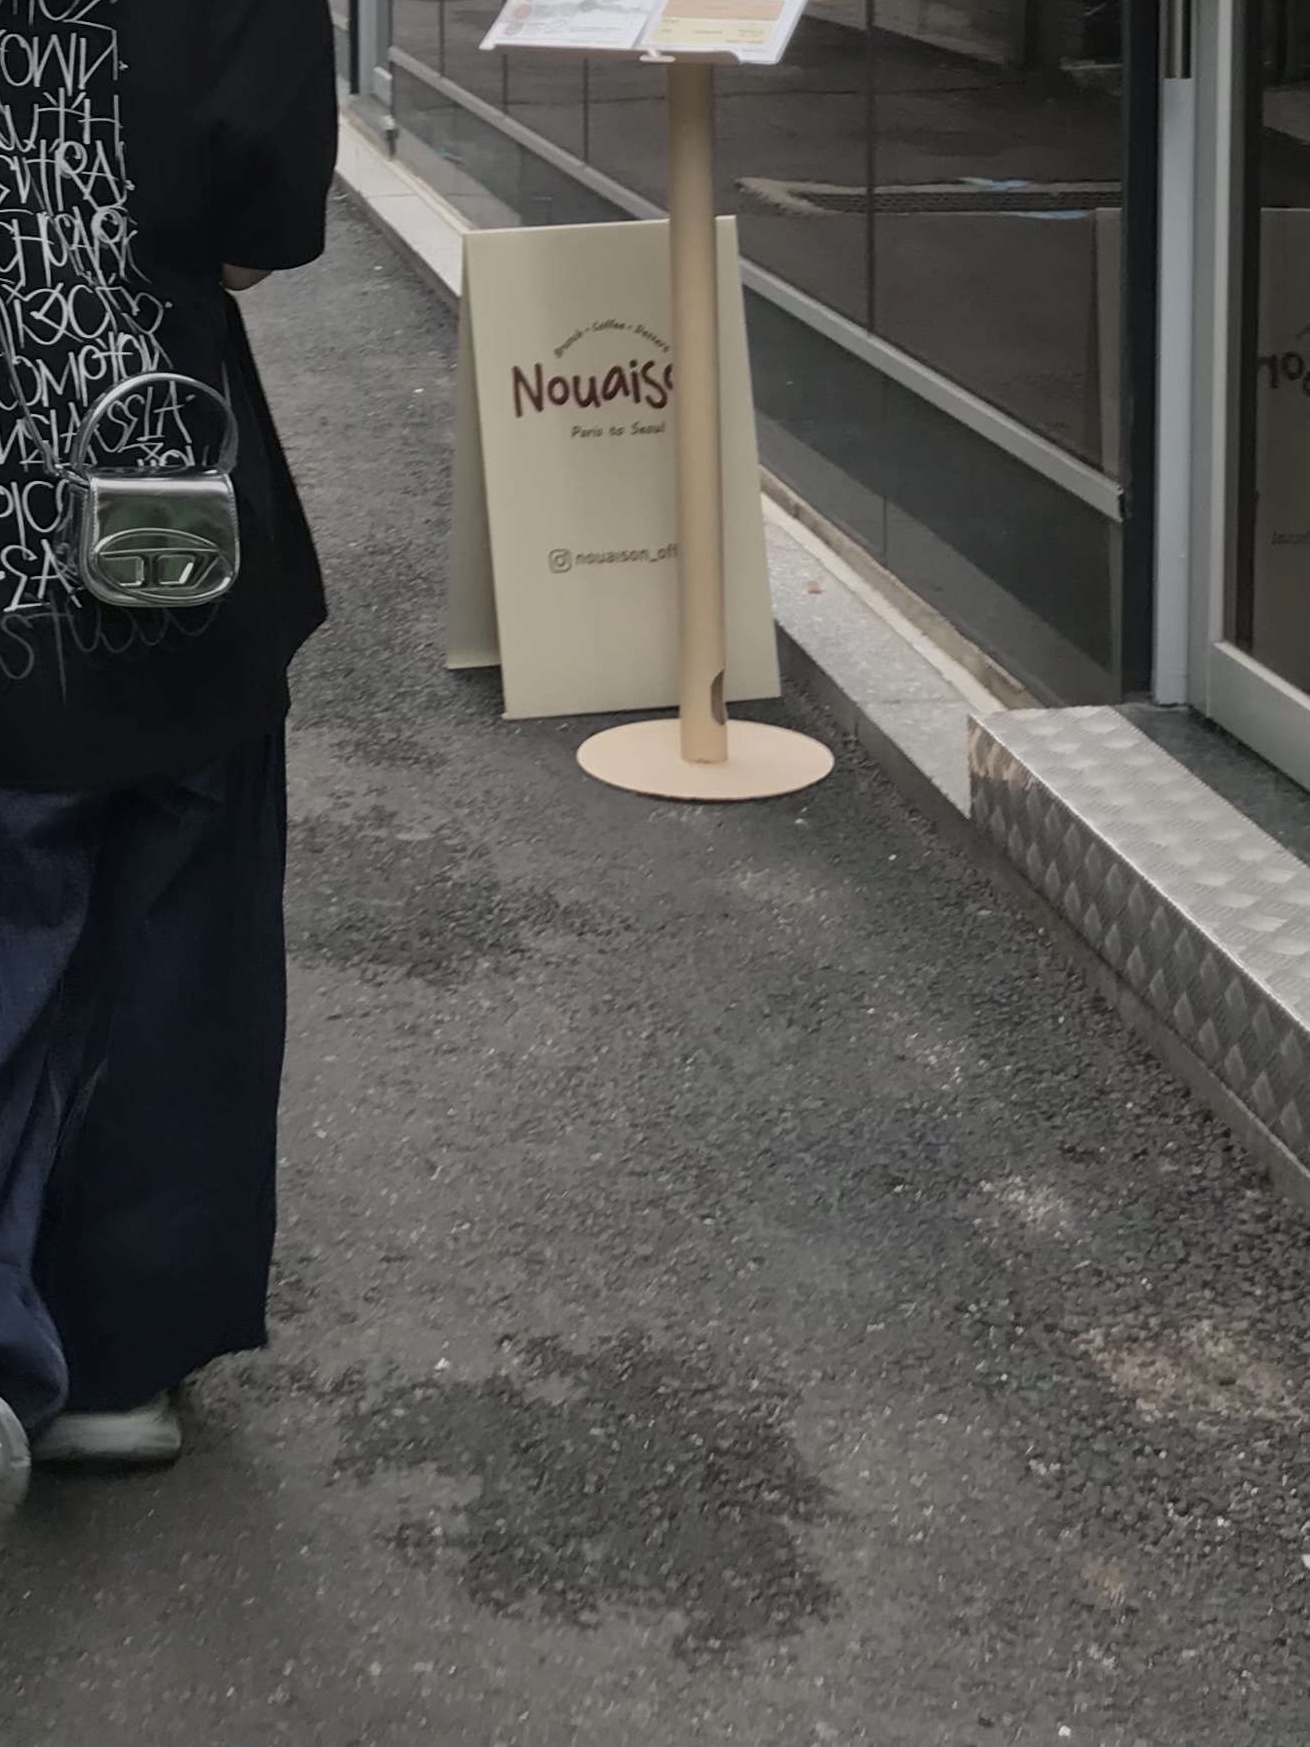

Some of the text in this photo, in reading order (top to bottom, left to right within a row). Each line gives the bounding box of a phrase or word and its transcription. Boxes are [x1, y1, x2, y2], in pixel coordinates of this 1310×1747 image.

[592, 318, 626, 332] Coffee
[570, 420, 667, 440] Paris to Seoul
